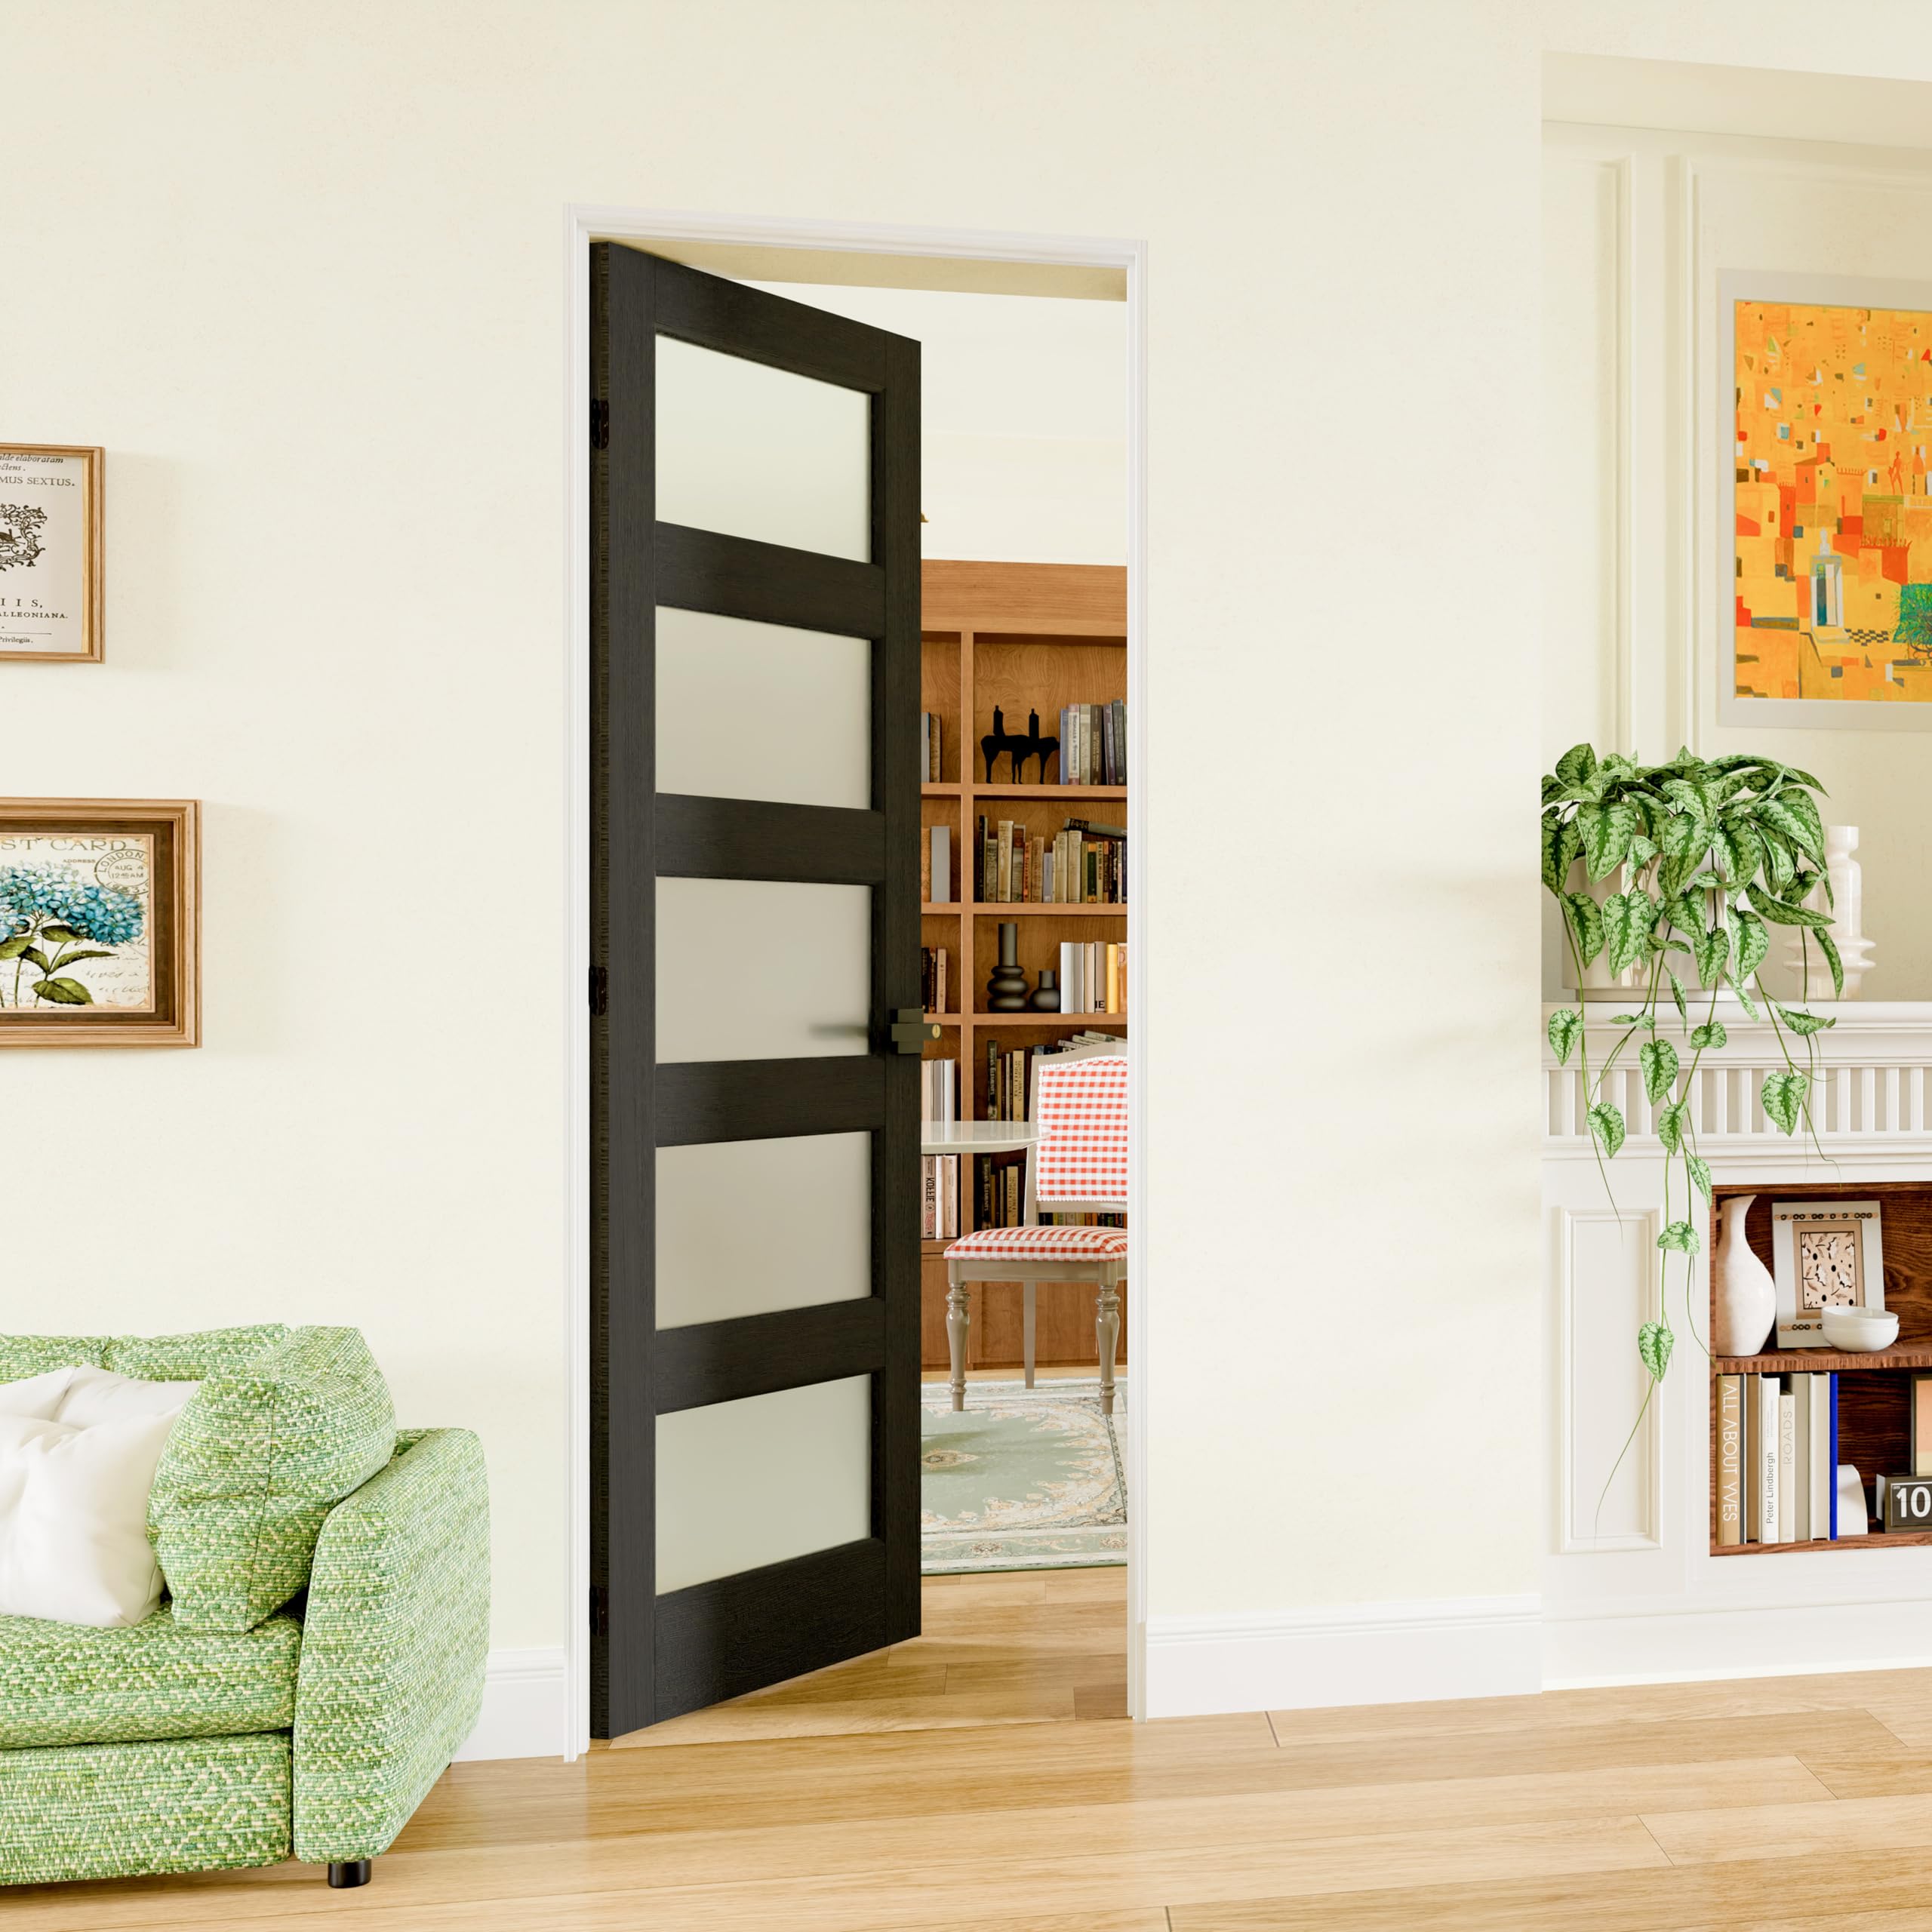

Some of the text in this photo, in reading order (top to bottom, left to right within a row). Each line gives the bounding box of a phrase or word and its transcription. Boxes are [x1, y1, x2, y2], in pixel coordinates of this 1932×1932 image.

[16, 454, 63, 463] elaboratam
[26, 477, 75, 487] SEXTUS.
[1, 838, 127, 851] ST CARD
[1723, 1383, 1738, 1414] ALL
[1723, 1419, 1738, 1475] ABOUT
[1783, 1410, 1793, 1466] ROADS
[1766, 1452, 1776, 1524] Peter Lindbergh
[1896, 1486, 1932, 1518] 10
